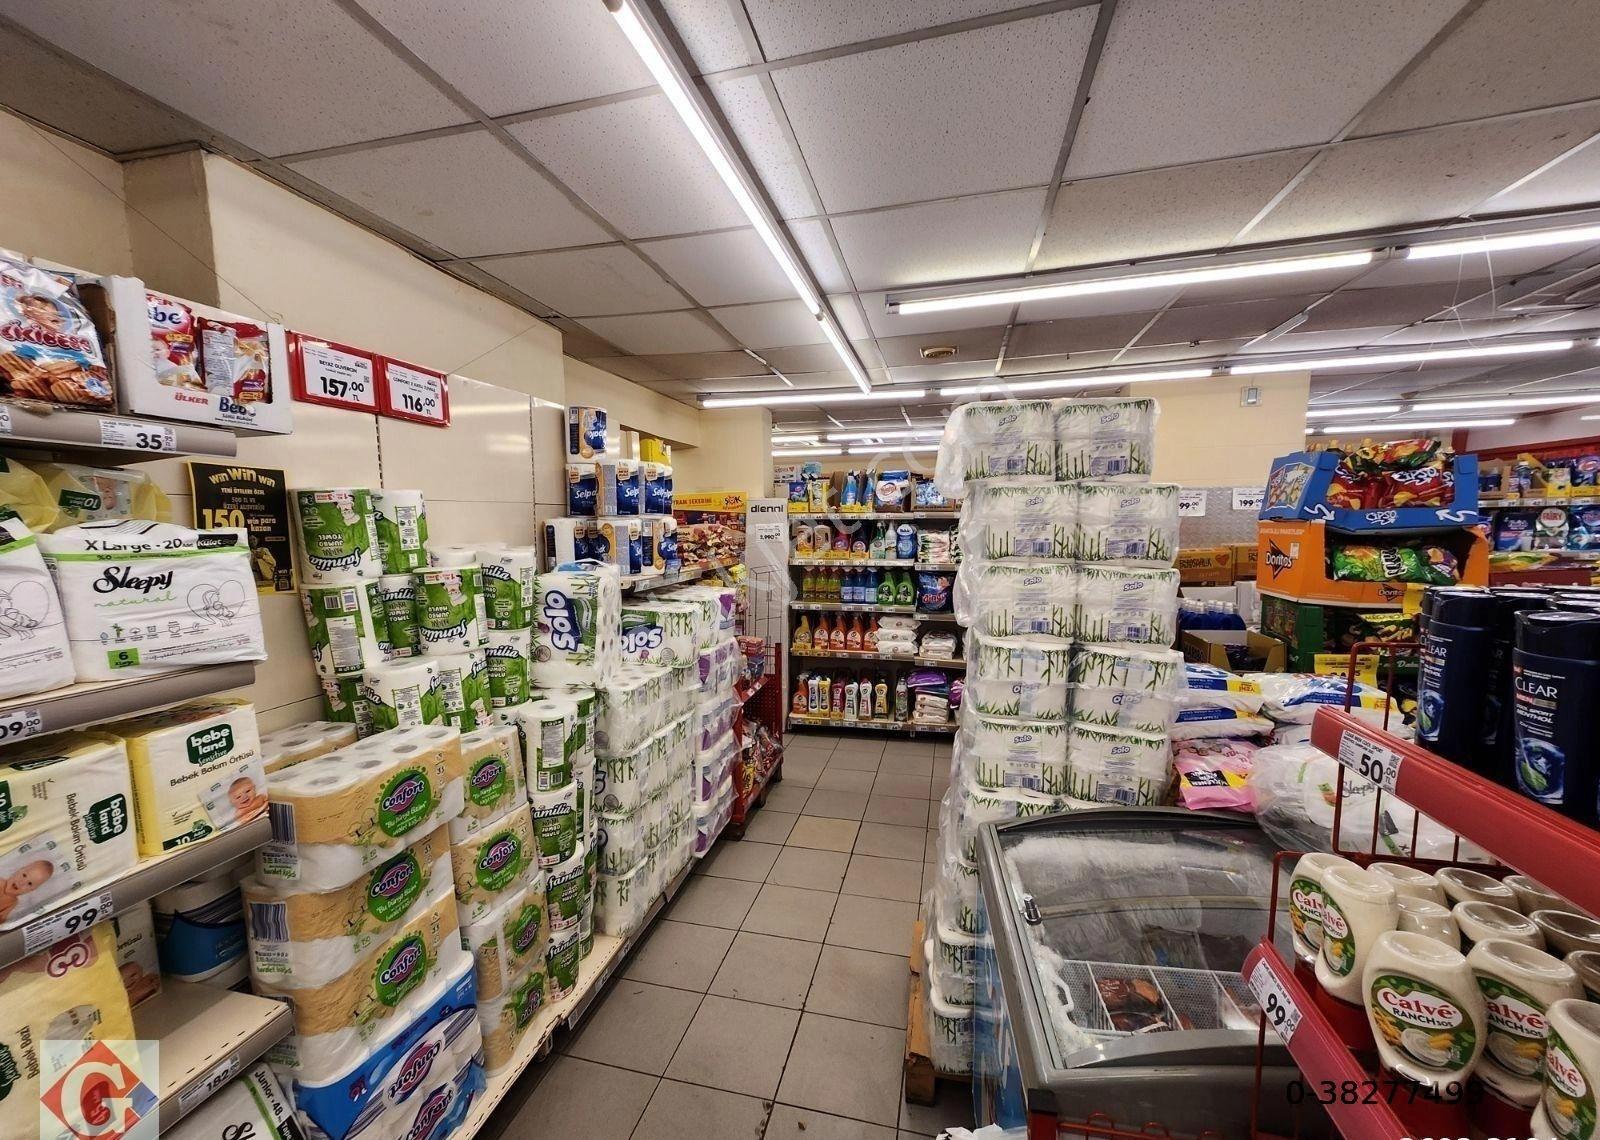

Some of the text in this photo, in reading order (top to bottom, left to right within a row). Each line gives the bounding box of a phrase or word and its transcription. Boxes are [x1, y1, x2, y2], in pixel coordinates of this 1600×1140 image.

[174, 392, 208, 405] ÜLKER
[998, 413, 1018, 427] Solo
[1100, 411, 1119, 424] Solo
[208, 472, 229, 484] win
[257, 475, 275, 487] win
[1025, 496, 1044, 508] Solo
[1120, 496, 1141, 509] Solo
[203, 508, 245, 530] 150
[1543, 512, 1562, 521] FAIRY
[84, 540, 98, 551] X
[103, 541, 152, 553] Large
[308, 547, 362, 571] familia
[1265, 553, 1293, 568] Doritos
[93, 566, 174, 594] Sleepy
[1023, 575, 1042, 587] Solo
[1123, 580, 1144, 592] Solo
[421, 618, 467, 642] familia
[544, 589, 577, 652] Solo
[118, 651, 129, 661] 6
[1515, 676, 1558, 699] CLEAR
[1516, 708, 1554, 724] MENTHOL
[191, 726, 230, 748] bebe
[198, 738, 227, 755] land
[1013, 734, 1032, 745] Solo
[1111, 745, 1131, 756] Solo
[170, 749, 254, 787] Bebek Bakım Örtüsü
[471, 766, 502, 787] Confort
[382, 780, 425, 810] Confort
[66, 793, 77, 819] Bebek
[110, 797, 124, 834] bebe
[99, 808, 112, 835] land
[480, 839, 517, 870] Confort
[371, 861, 415, 897] Confort
[380, 943, 422, 985] Confort
[1382, 991, 1456, 1019] Calvé
[1487, 1001, 1547, 1029] alvé
[1392, 1007, 1436, 1026] RANCH
[1488, 1015, 1524, 1034] ANCH
[1548, 1052, 1580, 1089] alvé
[254, 1071, 284, 1116] Junior 48
